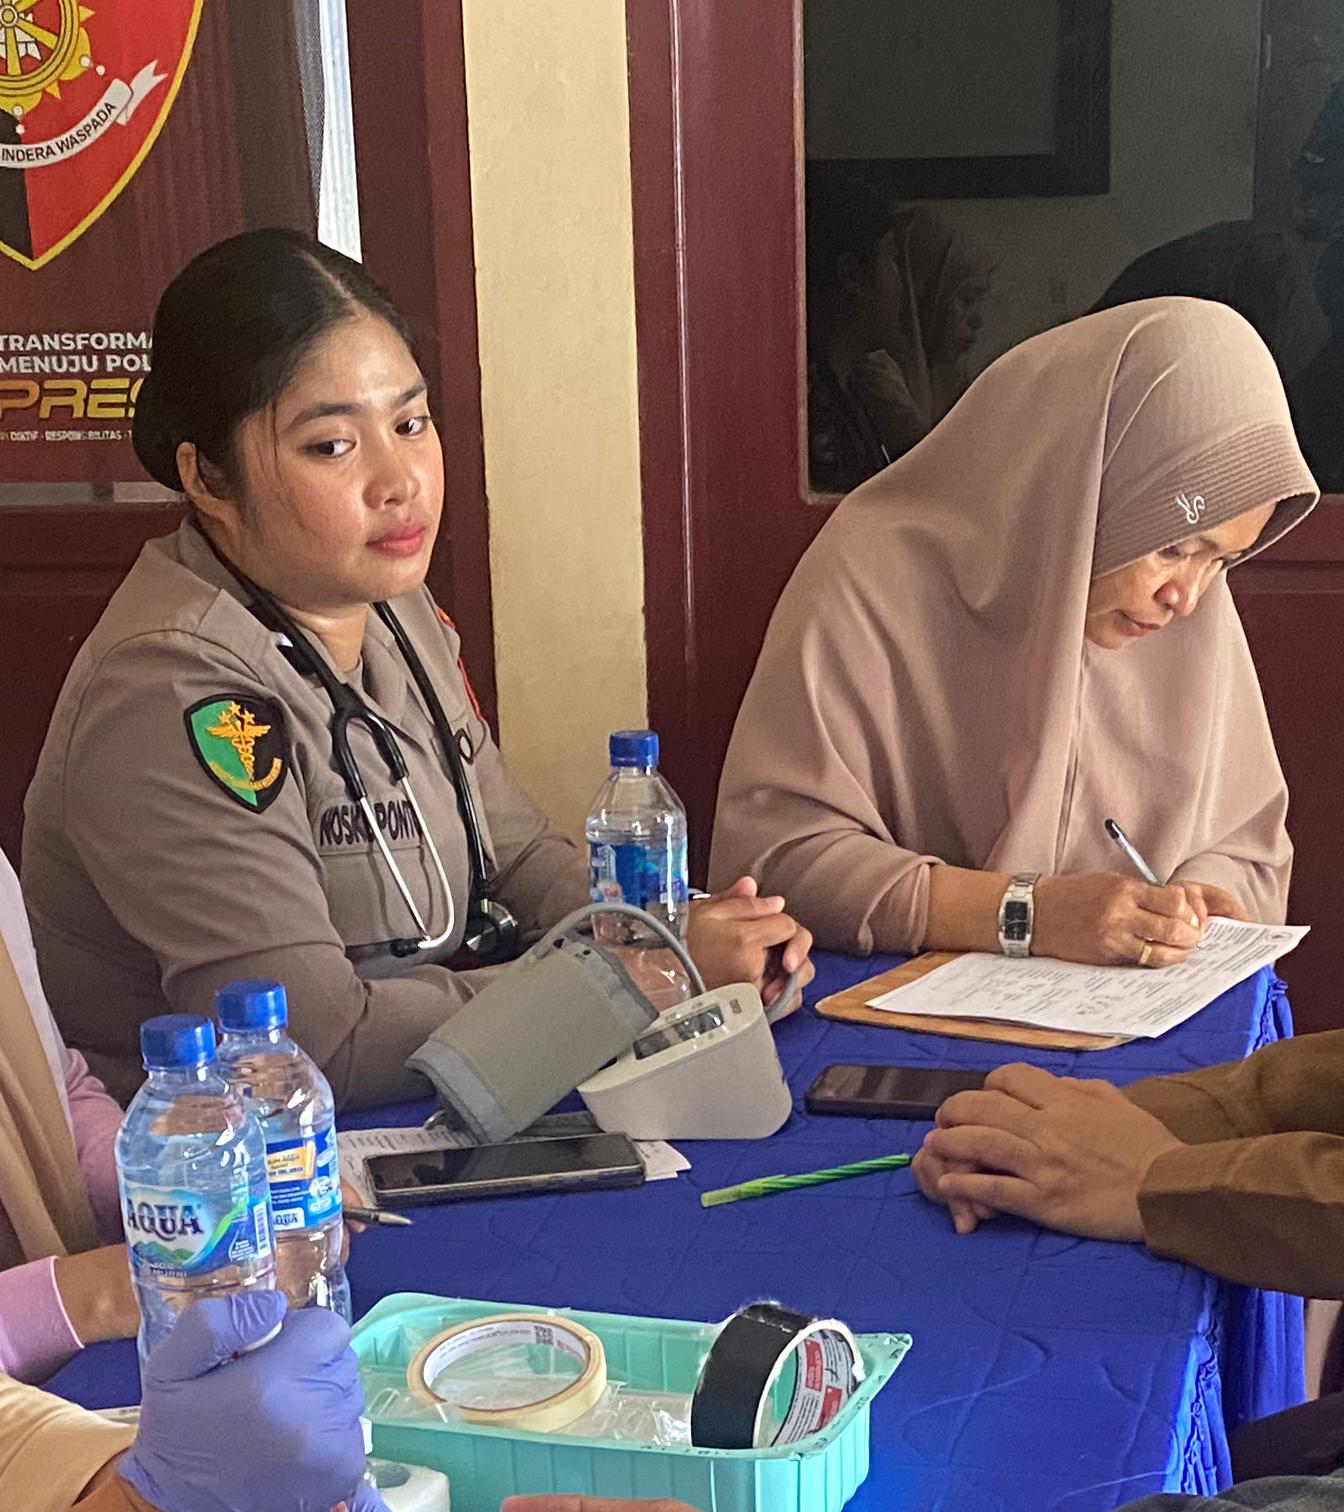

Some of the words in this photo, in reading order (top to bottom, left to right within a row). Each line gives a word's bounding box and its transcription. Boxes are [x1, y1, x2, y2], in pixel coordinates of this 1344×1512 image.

[1, 147, 56, 162] INDERA
[57, 102, 116, 153] WASPADA
[127, 1198, 203, 1241] AQUA
[273, 1213, 298, 1226] QUA
